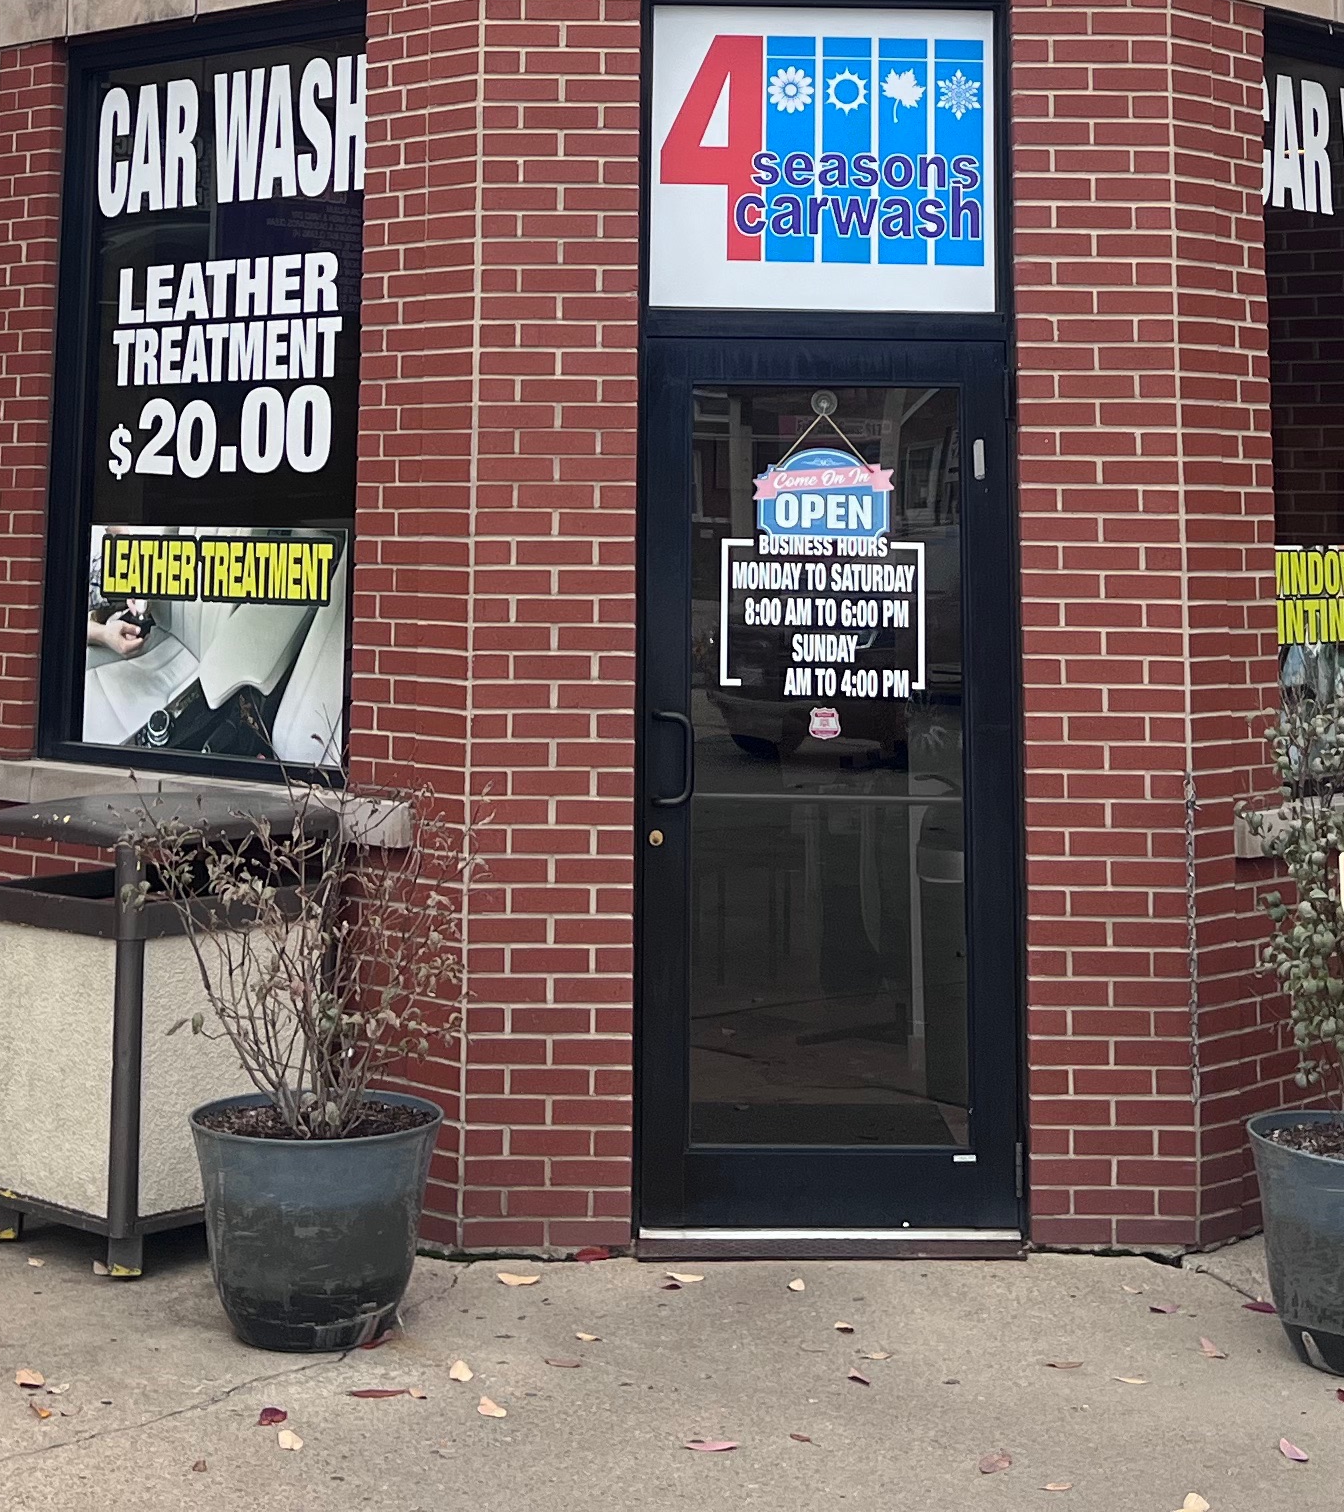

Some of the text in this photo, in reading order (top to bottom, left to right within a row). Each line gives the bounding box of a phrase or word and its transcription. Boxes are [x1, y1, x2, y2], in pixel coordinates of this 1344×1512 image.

[98, 53, 366, 218] CAR WASH
[660, 35, 763, 261] 4
[751, 150, 980, 189] seasons
[735, 183, 981, 240] carwash
[118, 251, 339, 325] LEATHER
[112, 317, 342, 386] TREATMENT
[108, 384, 332, 480] $20.00
[774, 469, 870, 489] Come On In
[775, 492, 872, 529] OPEN
[759, 536, 888, 558] BUSINESS HOURS
[103, 540, 333, 600] LEATHER TREATMENT
[732, 562, 915, 593] MONDAY TO SATURDAY
[745, 598, 909, 628] 8:00 AM TO 6:00 PM
[792, 634, 858, 663] SUNDAY
[784, 668, 909, 698] AM TO 4:00 PM
